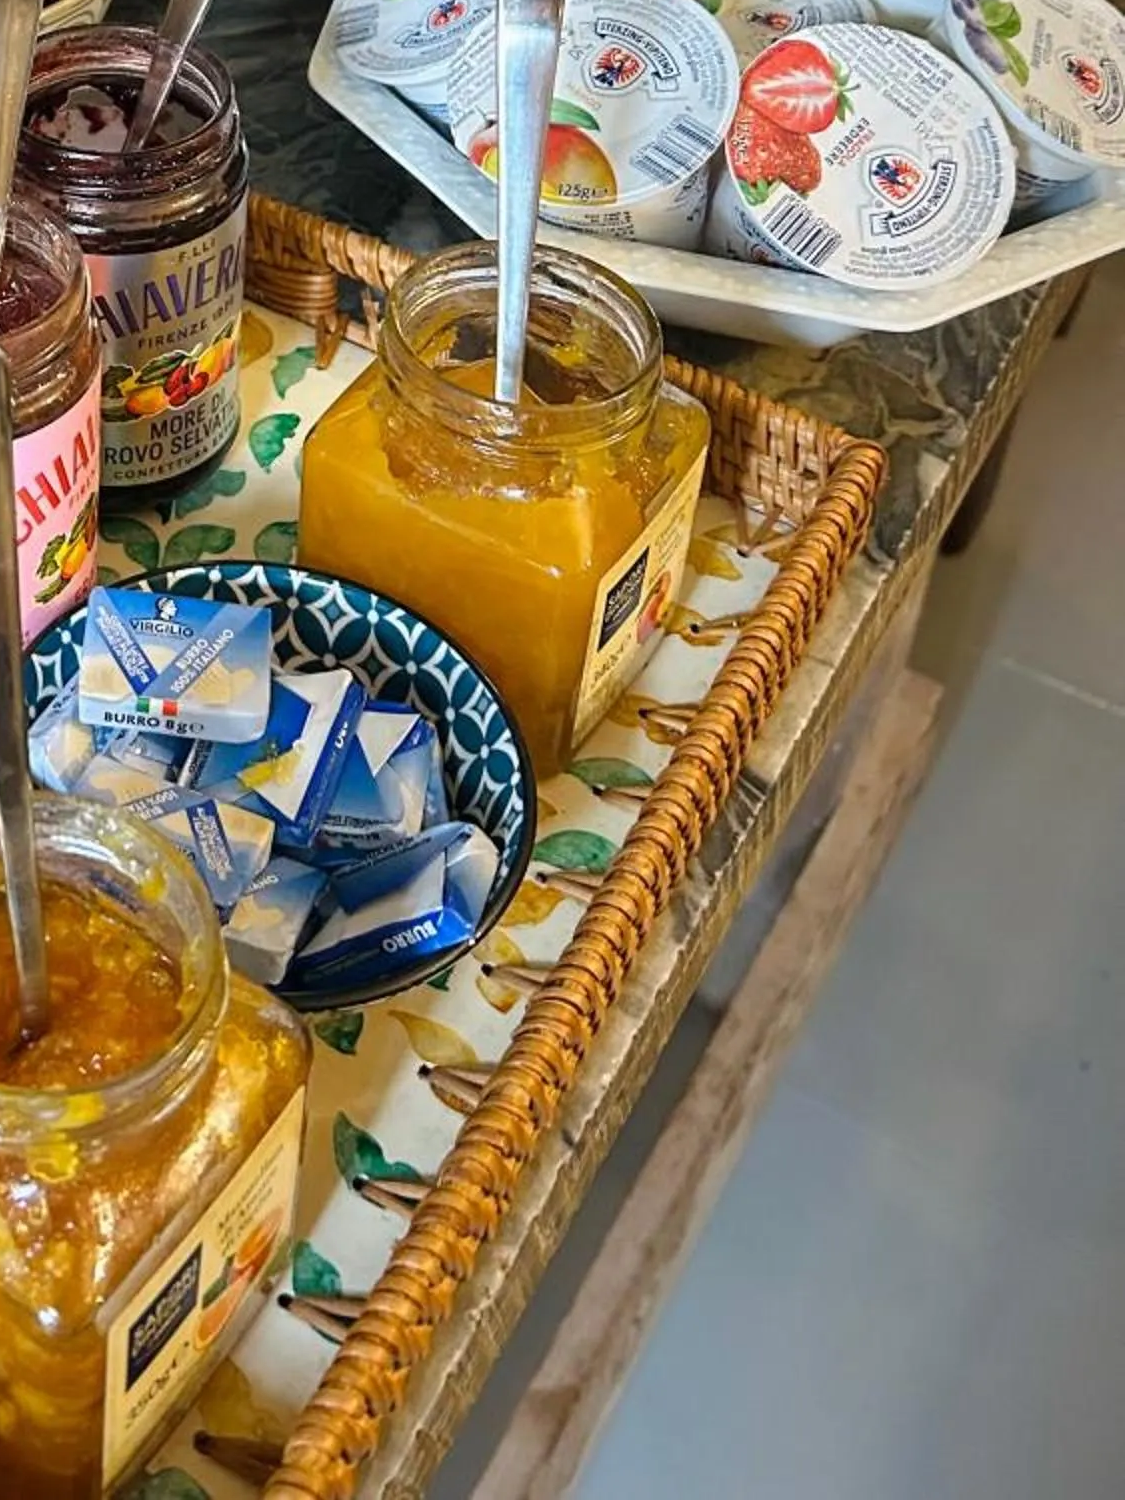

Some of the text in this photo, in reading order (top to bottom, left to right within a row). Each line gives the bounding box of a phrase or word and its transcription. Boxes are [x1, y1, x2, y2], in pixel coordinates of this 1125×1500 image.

[138, 318, 207, 349] FIRENZE
[149, 402, 206, 440] MORE
[104, 442, 164, 466] ROVO
[130, 619, 195, 638] VIRGILIO
[176, 638, 209, 671] BURRO
[191, 628, 235, 673] ITALIANO
[103, 711, 161, 728] BURRO
[382, 919, 438, 953] BURRO
